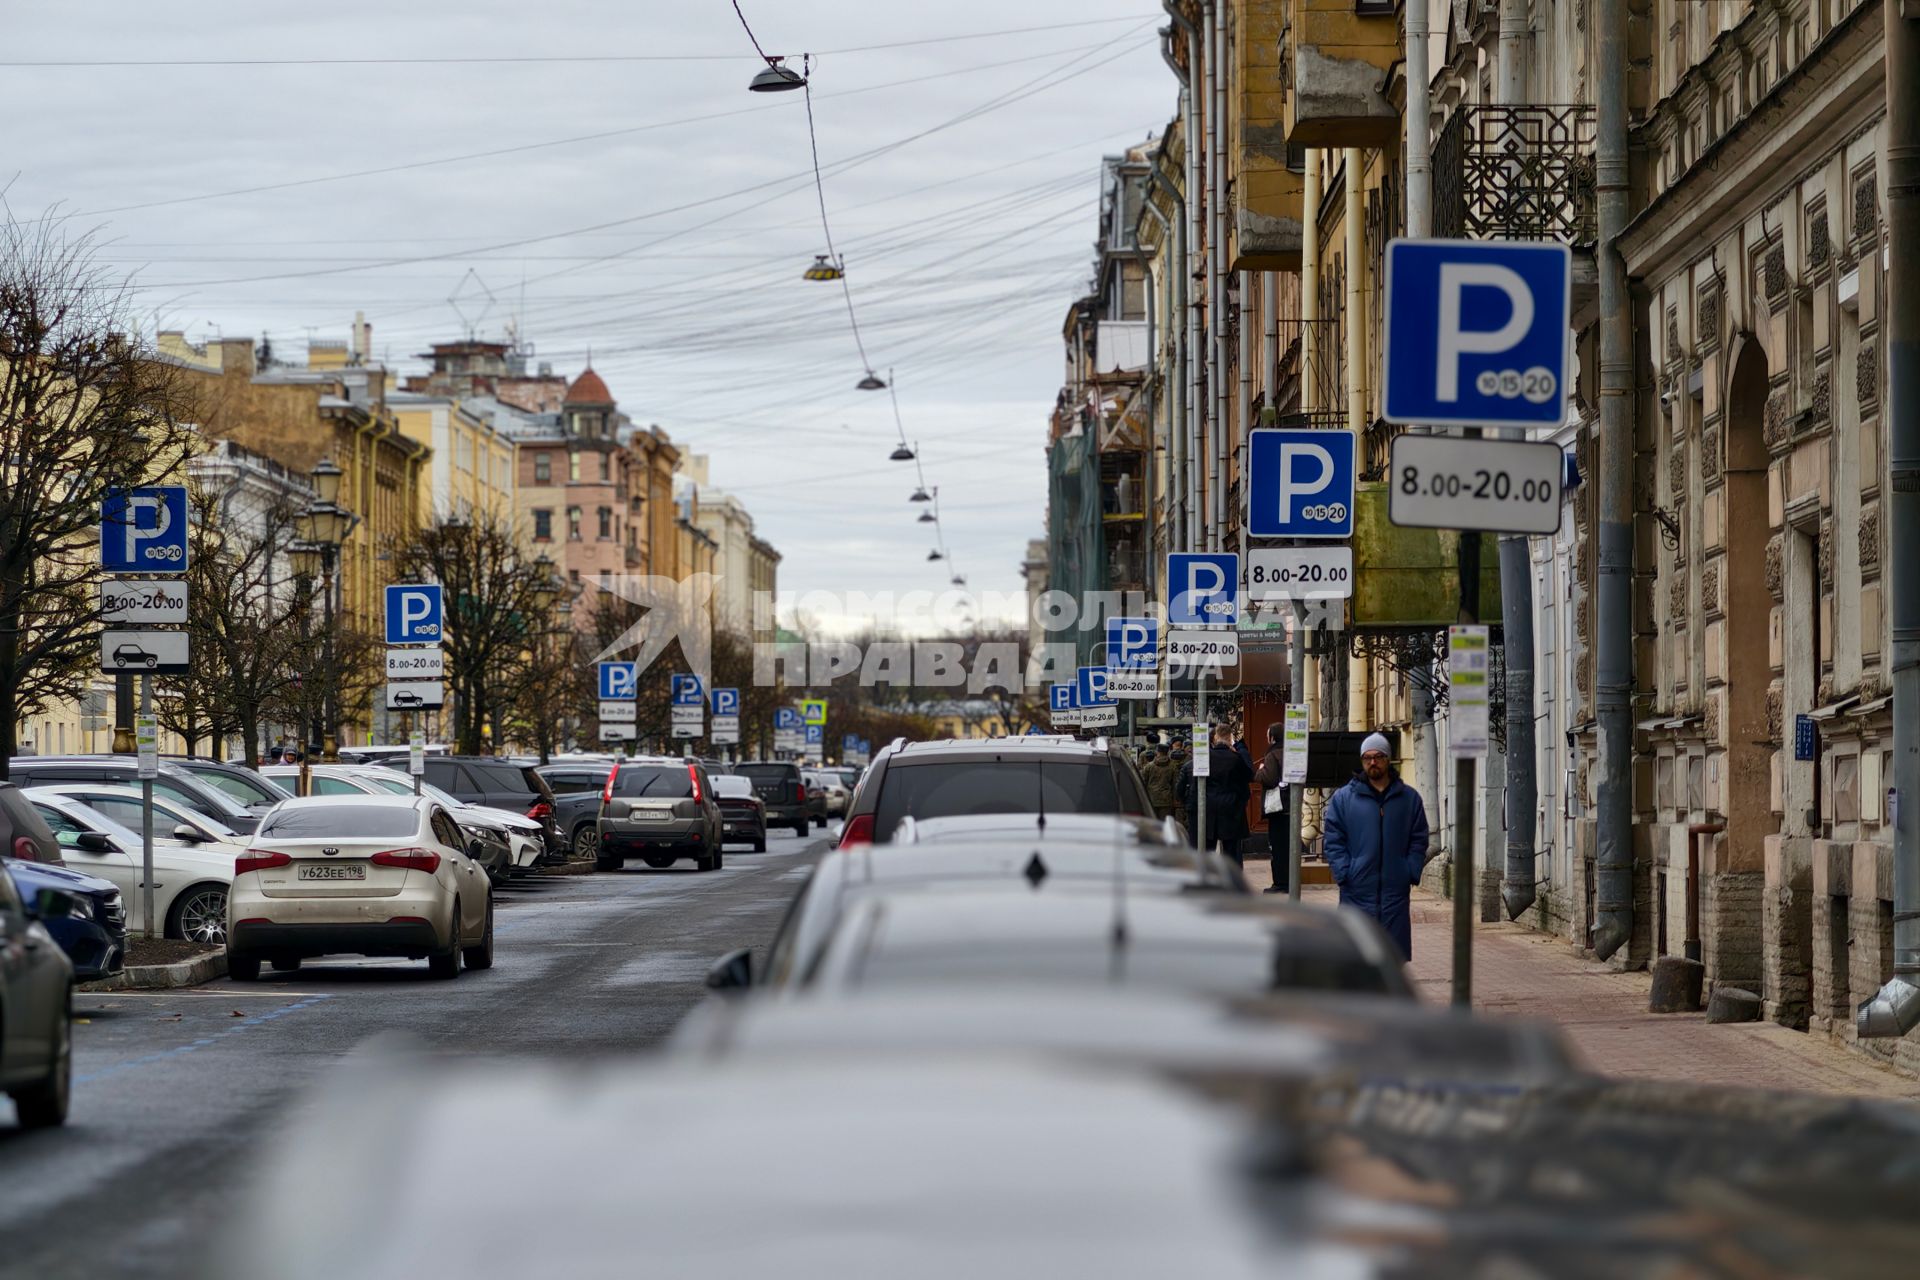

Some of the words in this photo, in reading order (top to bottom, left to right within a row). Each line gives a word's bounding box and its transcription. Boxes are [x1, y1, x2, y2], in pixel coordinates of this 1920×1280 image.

[1436, 262, 1535, 402] P
[1503, 377, 1519, 392] 15
[1525, 376, 1552, 394] 20
[1279, 443, 1335, 523] P
[1401, 465, 1552, 503] 8.00-20.00
[1316, 508, 1326, 518] 15
[1329, 507, 1345, 519] 20
[126, 496, 171, 562] P
[168, 548, 181, 558] 20
[1253, 564, 1348, 583] 8.00-20.00
[1188, 562, 1225, 616] P
[402, 592, 431, 636] P
[1122, 624, 1148, 662] P
[1171, 642, 1235, 655] 8.00-20.00
[389, 658, 440, 669] 8.00-20.00
[609, 666, 629, 695] P
[680, 678, 698, 702] P
[1109, 682, 1155, 692] 8.00-20.00
[718, 692, 734, 713] P
[779, 709, 793, 727] P
[346, 866, 363, 875] 198
